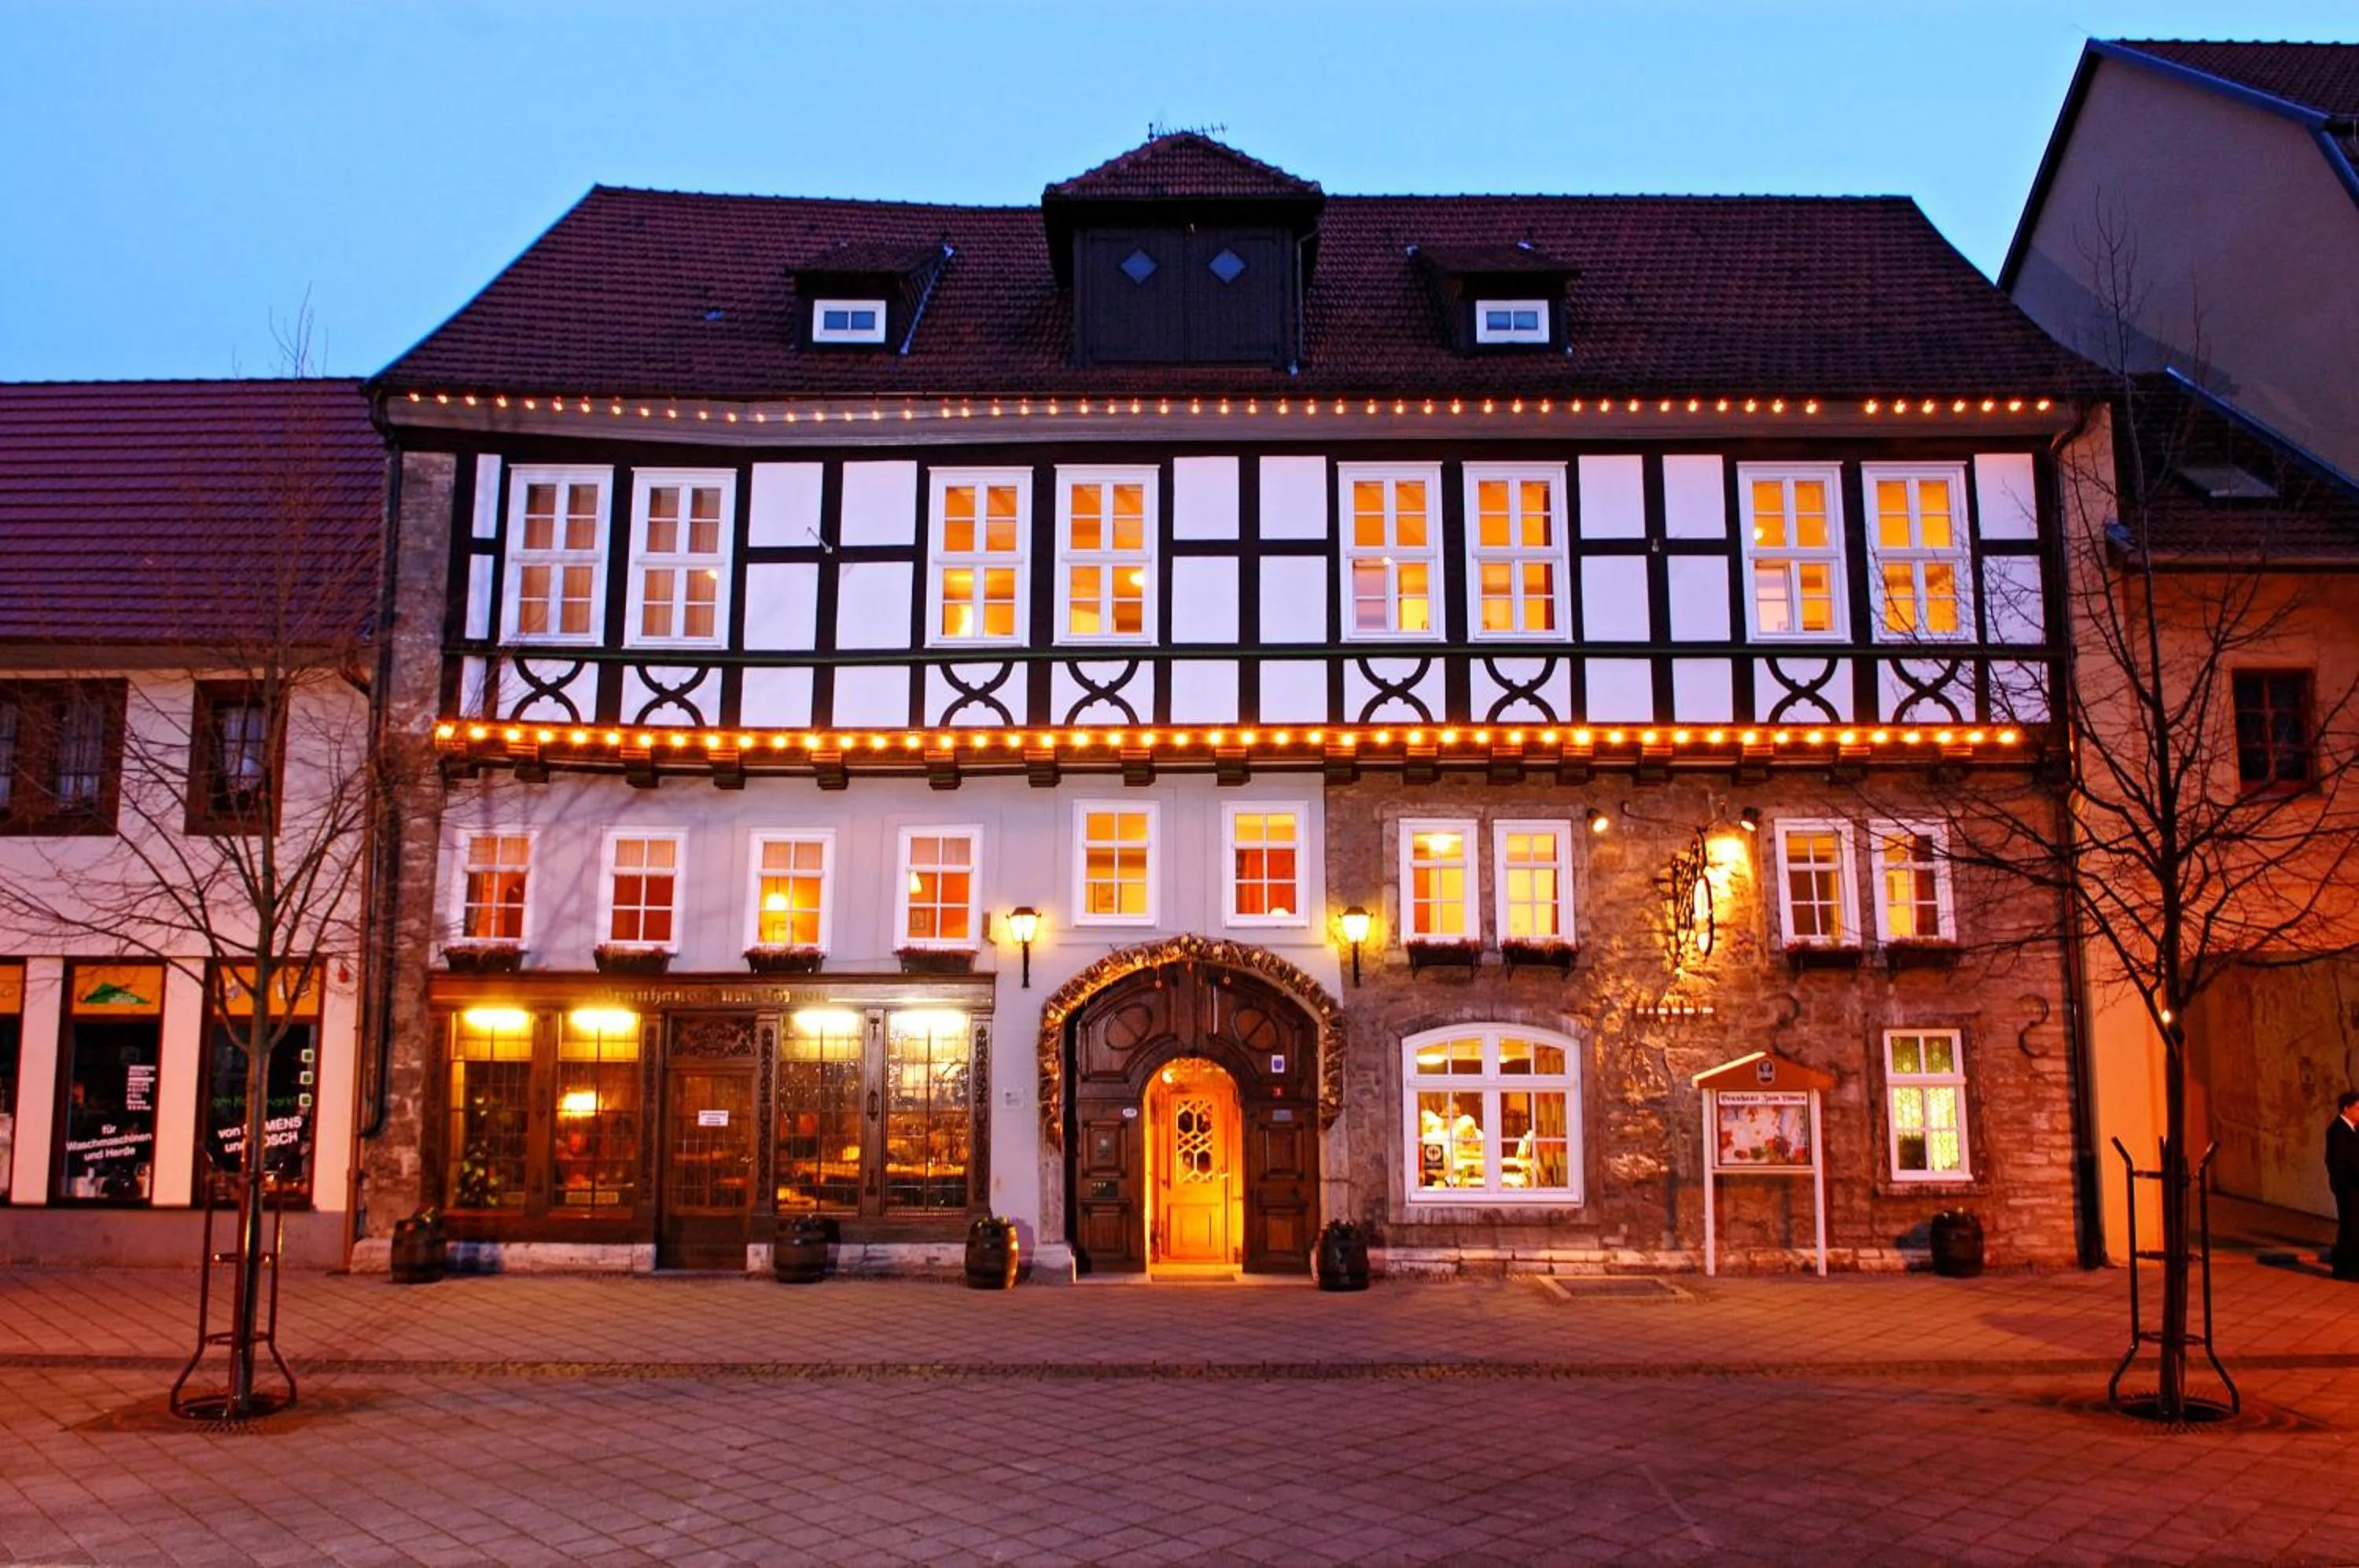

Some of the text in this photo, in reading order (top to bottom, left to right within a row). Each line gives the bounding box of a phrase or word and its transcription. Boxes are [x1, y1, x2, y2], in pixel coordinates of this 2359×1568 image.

[101, 1124, 116, 1134] für
[217, 1116, 303, 1139] von SMENS
[83, 1146, 136, 1161] und Herde
